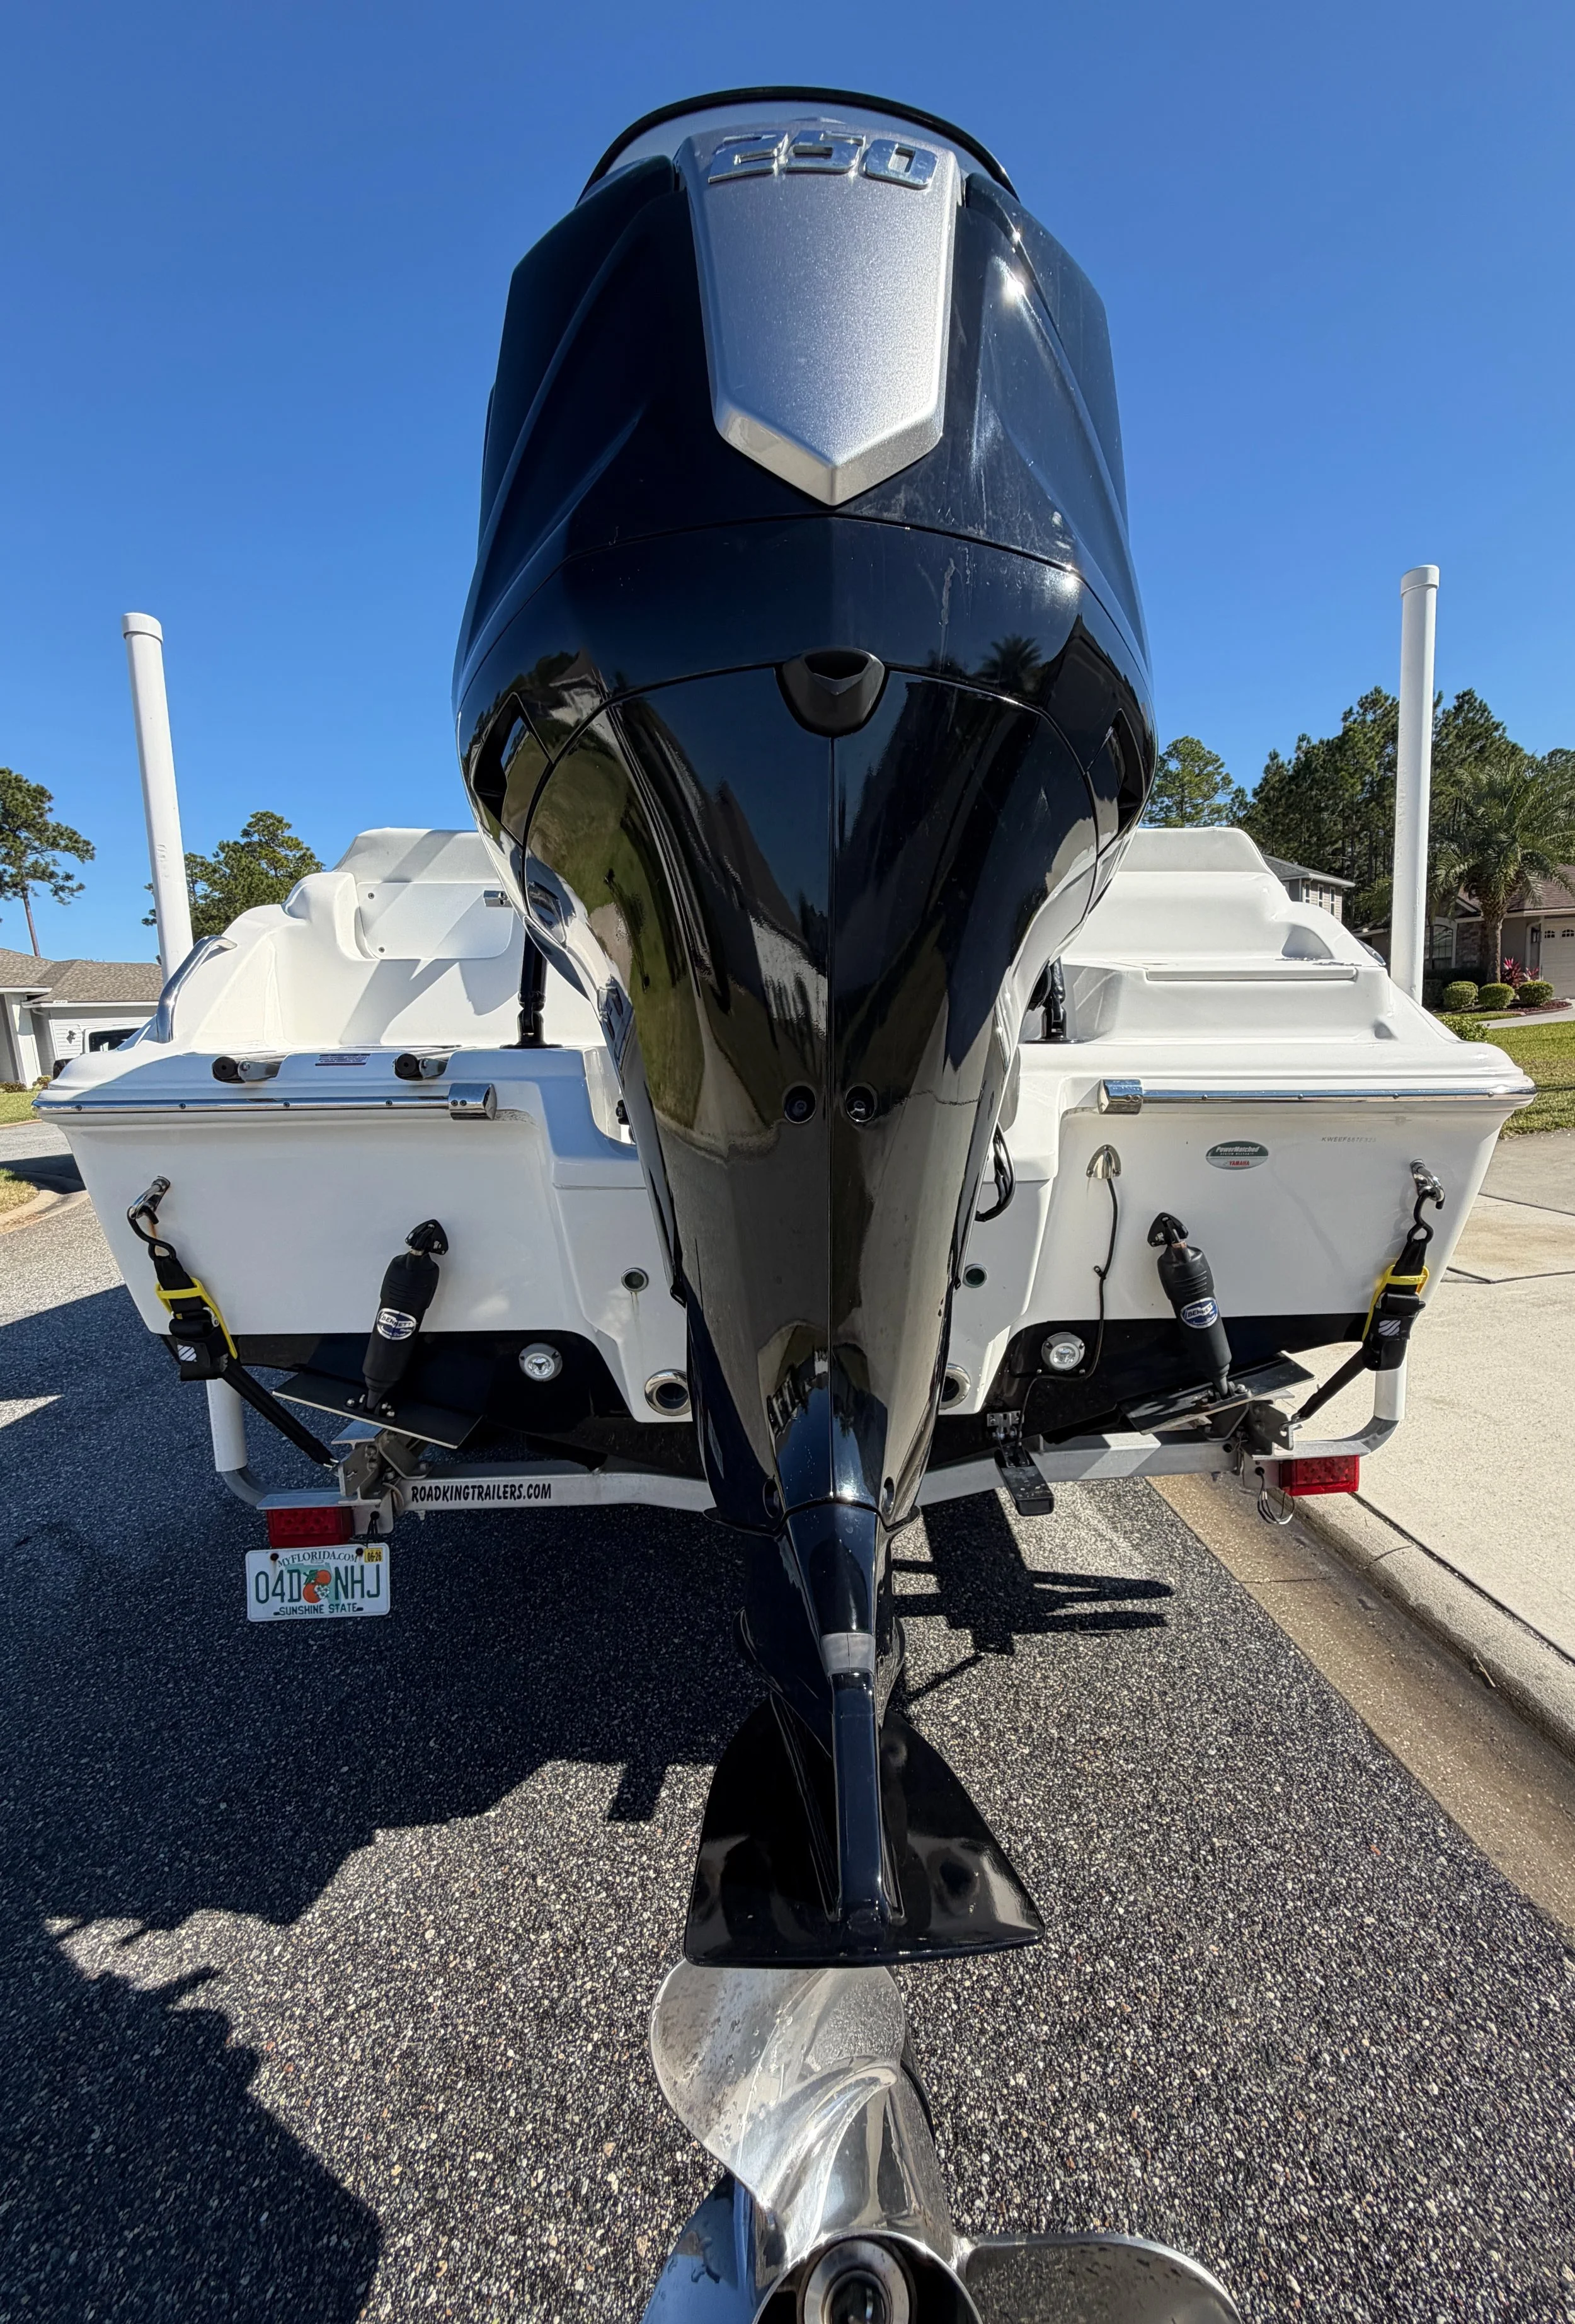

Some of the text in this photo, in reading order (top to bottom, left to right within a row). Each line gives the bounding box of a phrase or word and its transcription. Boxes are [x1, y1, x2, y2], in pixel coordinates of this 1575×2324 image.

[708, 129, 939, 191] 250
[411, 1483, 552, 1503] ROADKINGTRAILERS.COM
[278, 1551, 358, 1568] MYFLORIDA.COM
[335, 1564, 380, 1600] NHJ
[279, 1602, 358, 1616] SUNSHINE STATE
